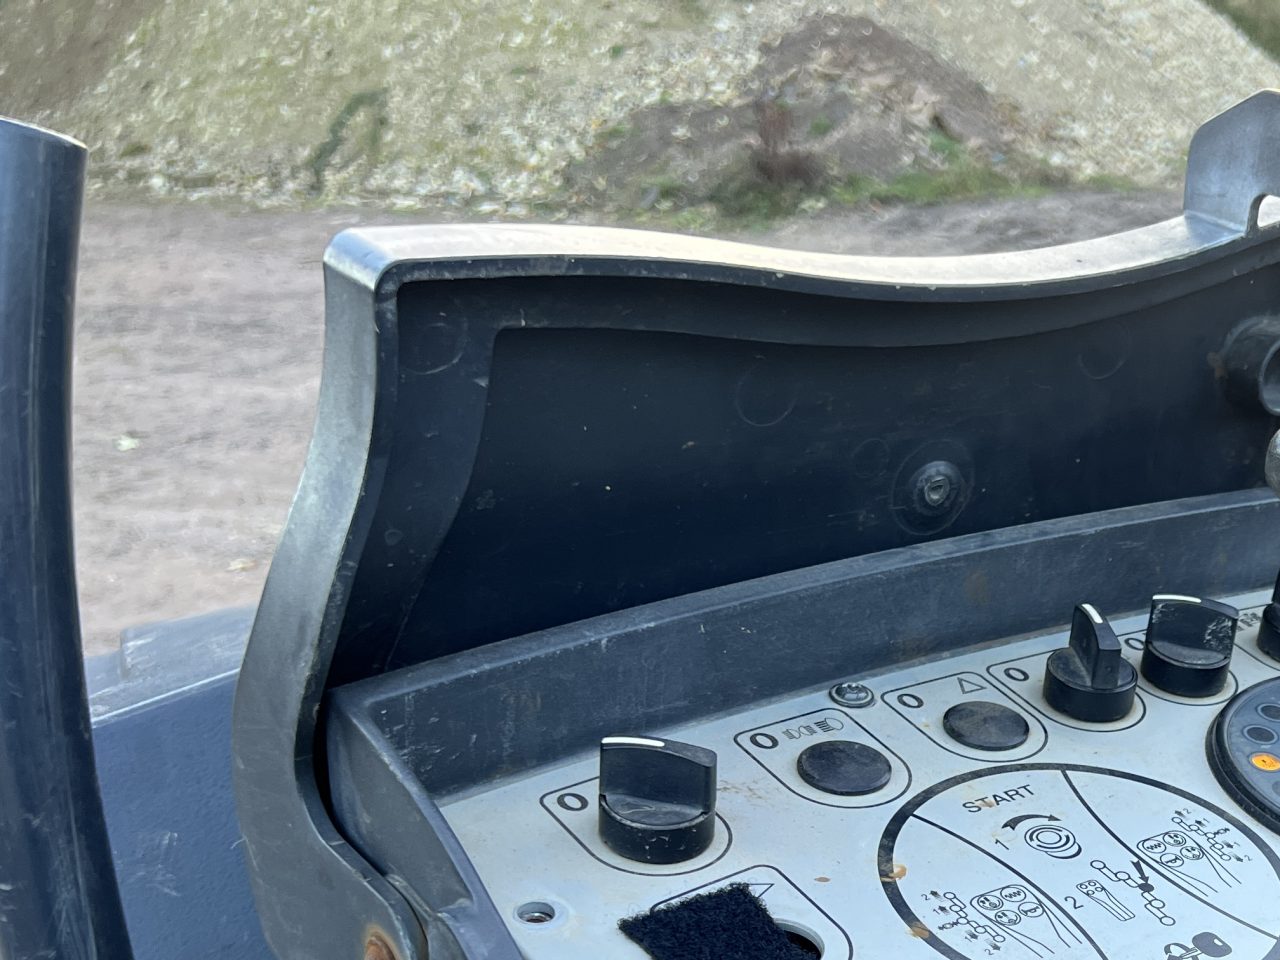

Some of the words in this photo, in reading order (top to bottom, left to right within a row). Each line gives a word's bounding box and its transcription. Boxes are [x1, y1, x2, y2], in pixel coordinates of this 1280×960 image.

[962, 784, 1034, 813] START
[995, 838, 1010, 851] 1
[1064, 895, 1084, 910] 2
